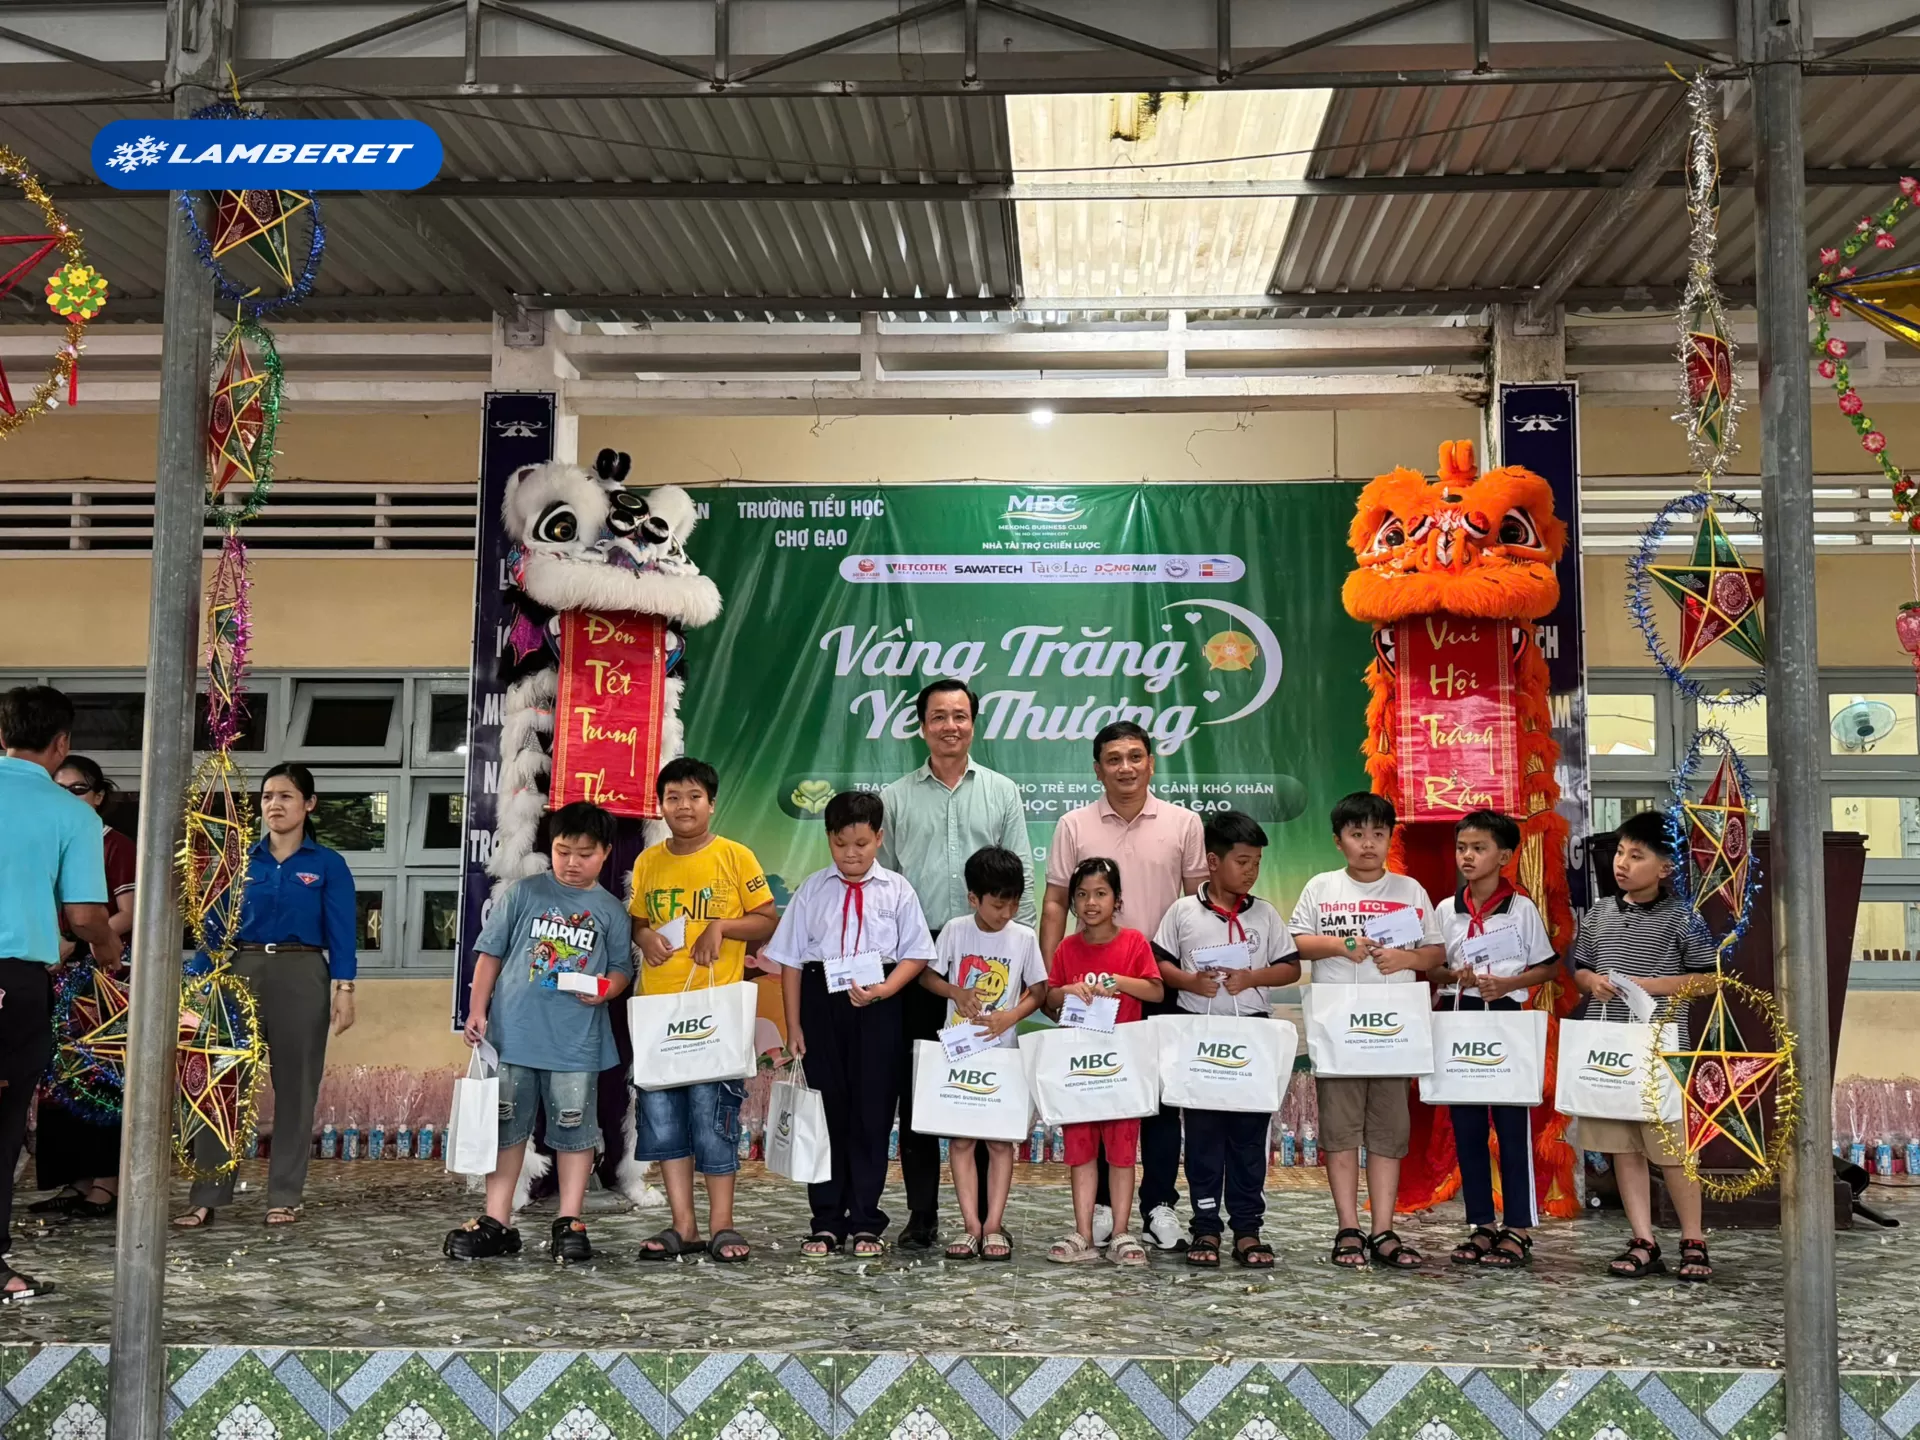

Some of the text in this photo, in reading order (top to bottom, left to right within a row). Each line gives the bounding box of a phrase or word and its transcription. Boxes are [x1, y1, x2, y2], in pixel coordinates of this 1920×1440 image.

[737, 494, 884, 520] TRƯỜNG TIỂU HỌC
[1007, 494, 1079, 512] MBC
[775, 528, 847, 550] CHỢ GẠO
[982, 540, 1101, 551] NHÀ TÀI TRỢ CHIẾN LƯỢC
[885, 564, 948, 573] VIETCOTEK
[954, 565, 1022, 574] SAWATECH
[583, 613, 636, 645] Đón
[1426, 617, 1480, 650] Vui
[819, 618, 1189, 693] Vầng Trăng
[585, 660, 631, 696] Tết
[1430, 663, 1480, 698] Hội
[574, 707, 637, 777] Trung
[1419, 714, 1494, 776] Trăng
[575, 767, 628, 804] Thu
[1040, 781, 1065, 793] TRẺ
[1068, 783, 1087, 793] EM
[1160, 781, 1198, 793] CẢNH
[1202, 781, 1232, 793] KHÓ
[1235, 782, 1273, 794] KHĂN
[1190, 800, 1232, 815] GẠO
[1319, 900, 1388, 913] Tháng TCL
[530, 918, 595, 951] MARVEL
[667, 1015, 712, 1036] MBC
[1350, 1012, 1398, 1027] MBC
[1197, 1041, 1247, 1060] MBC
[1452, 1042, 1502, 1056] MBC
[1587, 1049, 1633, 1068] MBC
[1070, 1052, 1117, 1071] MBC
[948, 1068, 997, 1086] MBC
